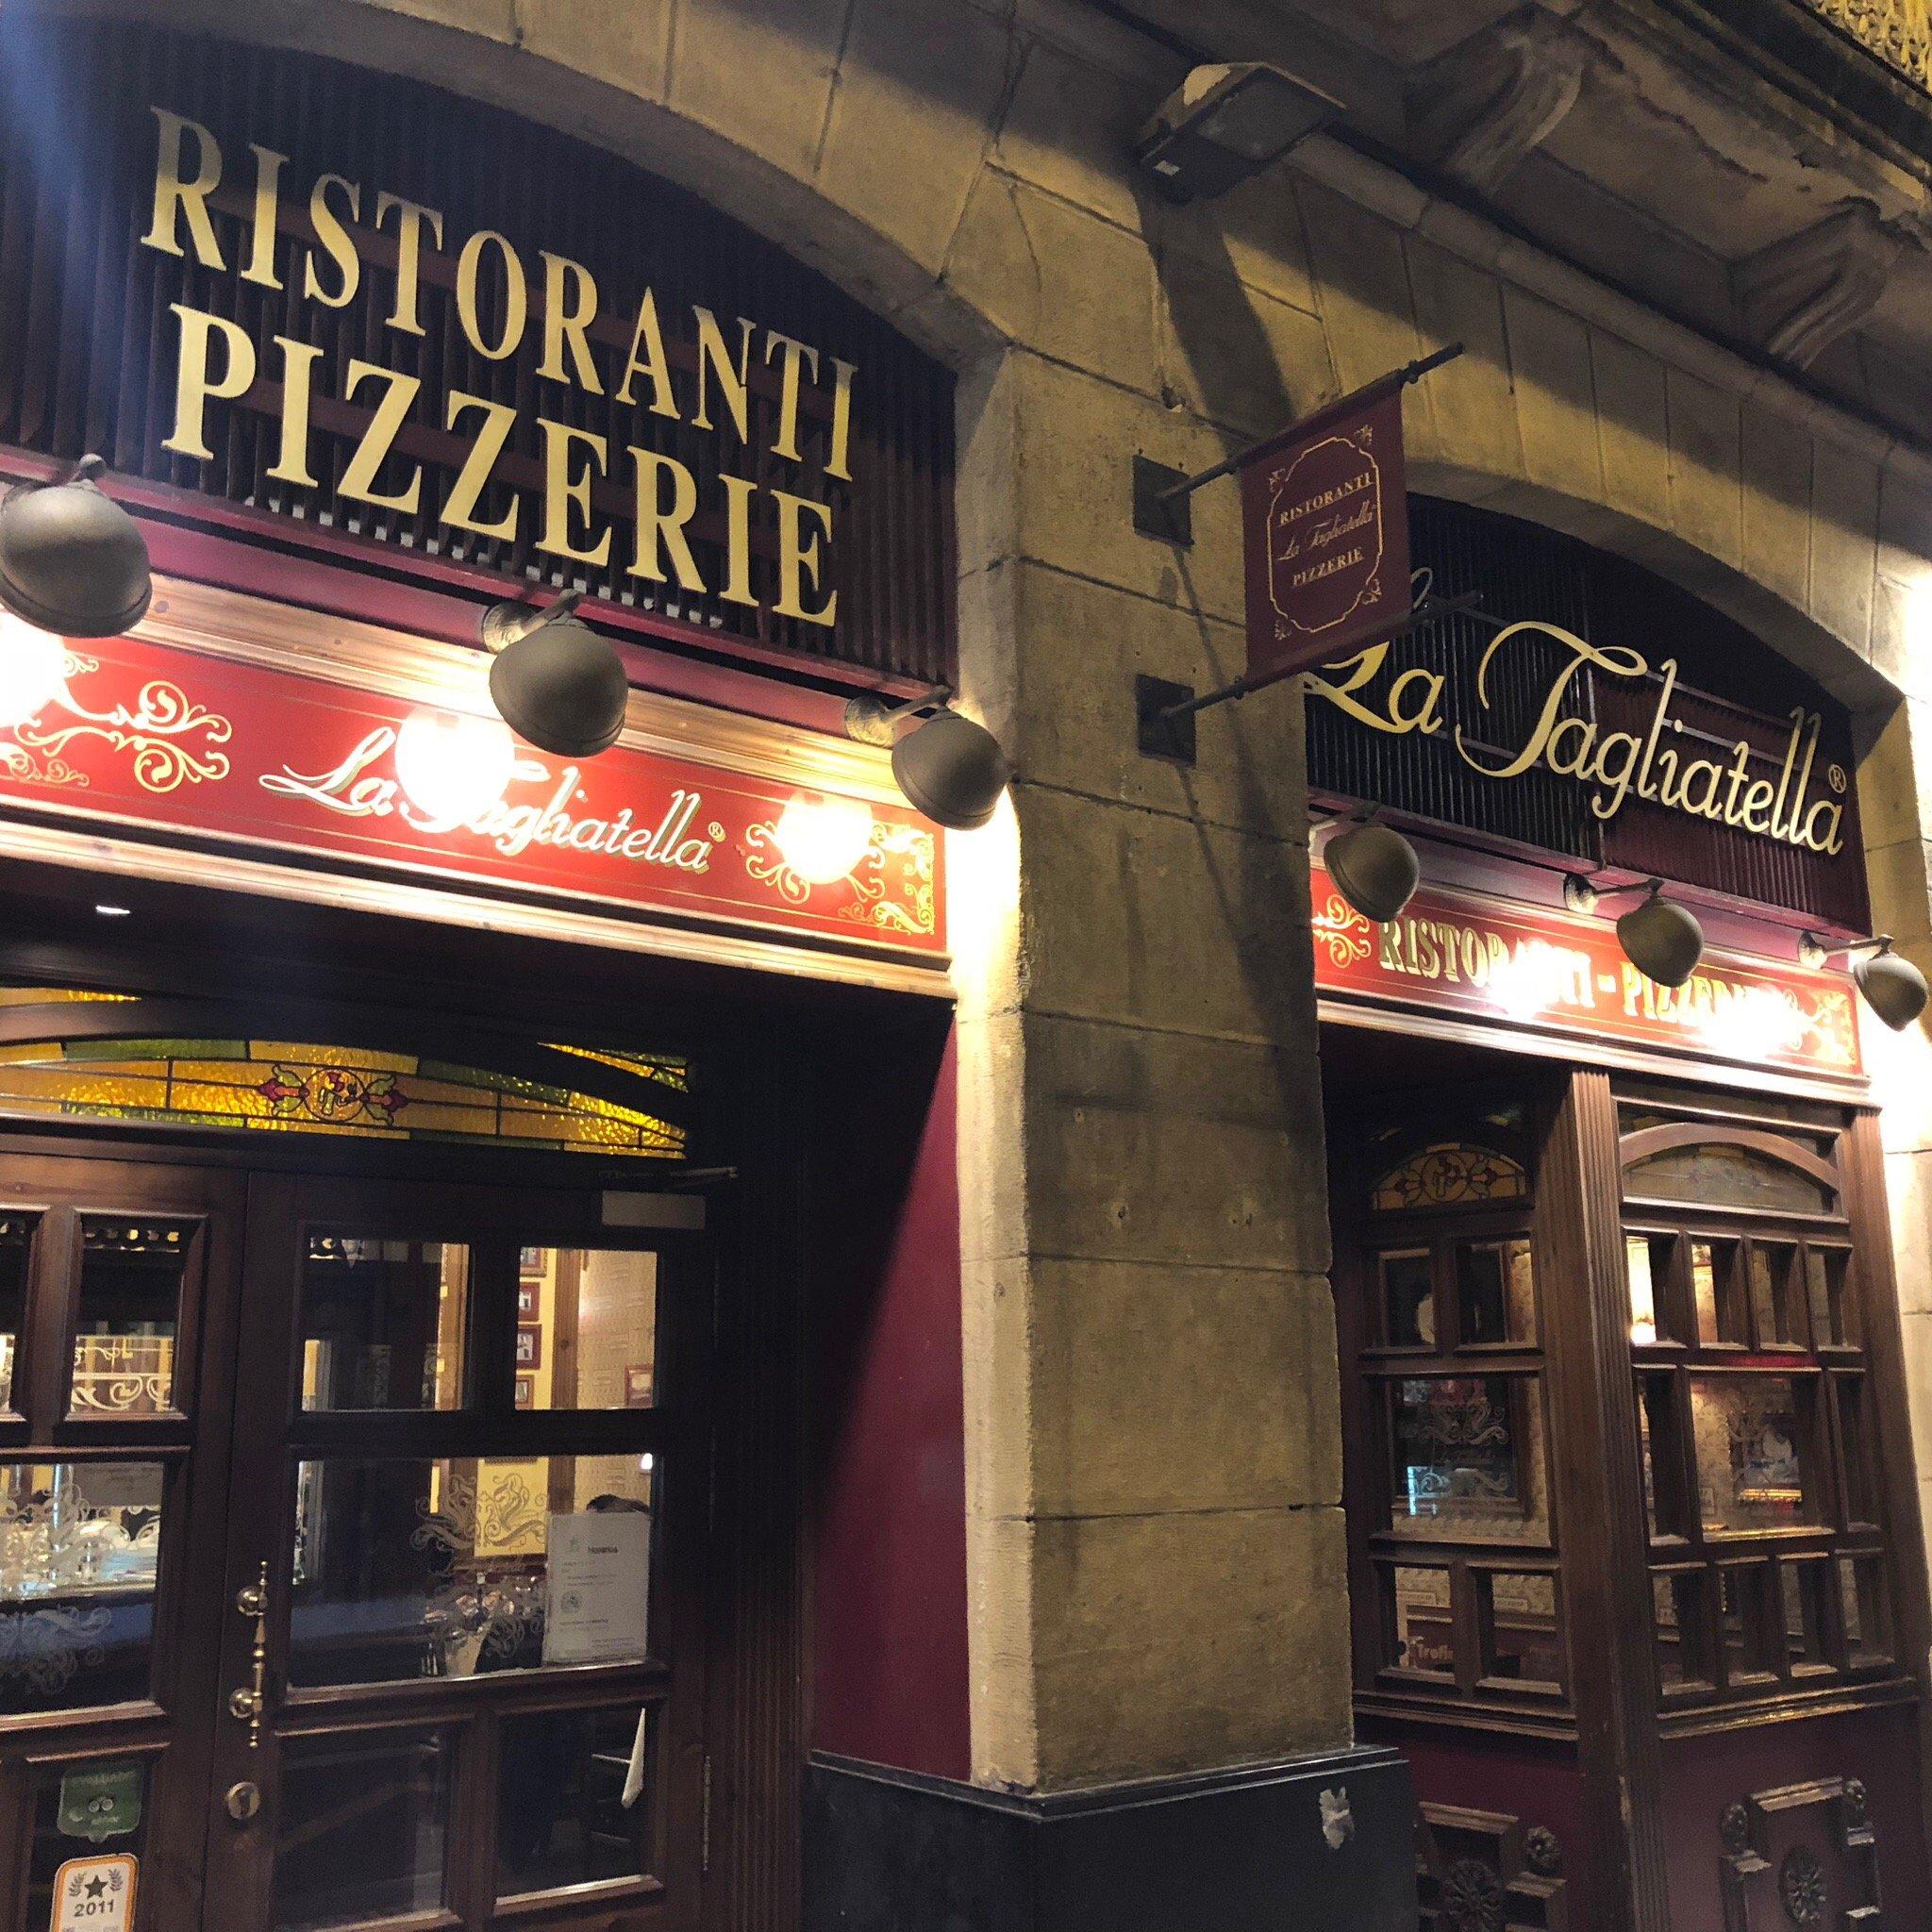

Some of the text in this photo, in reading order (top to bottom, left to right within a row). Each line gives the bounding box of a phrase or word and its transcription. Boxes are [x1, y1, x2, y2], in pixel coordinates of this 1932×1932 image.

[141, 105, 858, 483] RISTORANTI
[160, 303, 841, 628] PIZZERIE
[1280, 473, 1372, 525] RISTORANTI
[1292, 546, 1365, 586] PIZZERIE
[74, 1899, 115, 1918] 2011
